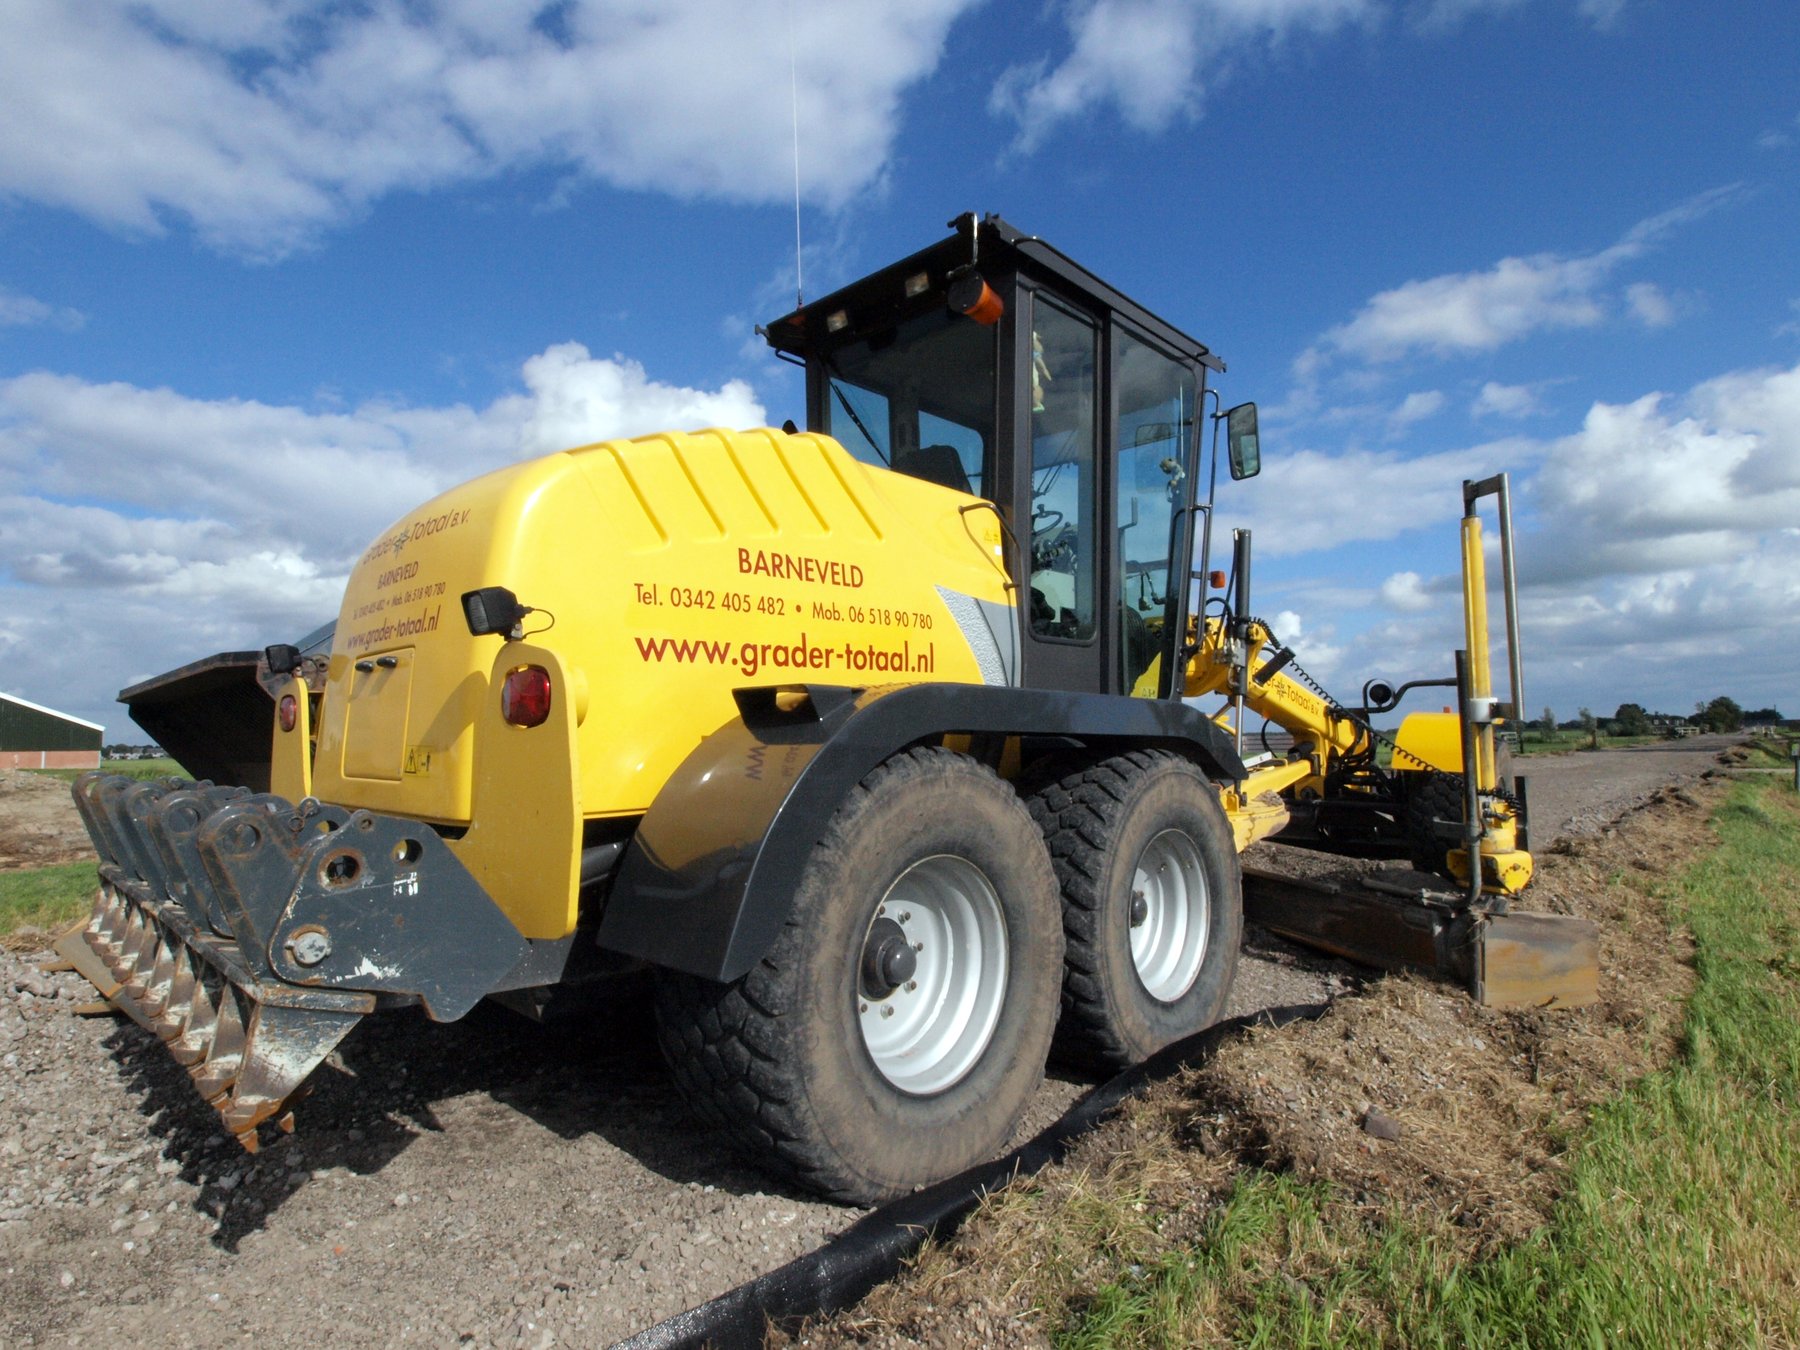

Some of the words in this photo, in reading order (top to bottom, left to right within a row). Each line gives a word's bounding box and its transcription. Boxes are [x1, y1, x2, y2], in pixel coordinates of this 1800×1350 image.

[410, 509, 454, 542] Totaal
[377, 561, 419, 590] BARNEVELD
[738, 547, 864, 588] BARNEVELD
[347, 604, 441, 651] www.grader-totaal.nl
[634, 583, 663, 606] Tel.
[670, 587, 715, 610] 0342
[721, 592, 751, 613] 405
[757, 596, 785, 616] 482
[812, 601, 845, 622] Mob.
[849, 605, 865, 623] 06
[869, 608, 891, 626] 518
[894, 610, 909, 627] 90
[912, 613, 933, 630] 780
[634, 632, 934, 677] www.grader-totaal.nl
